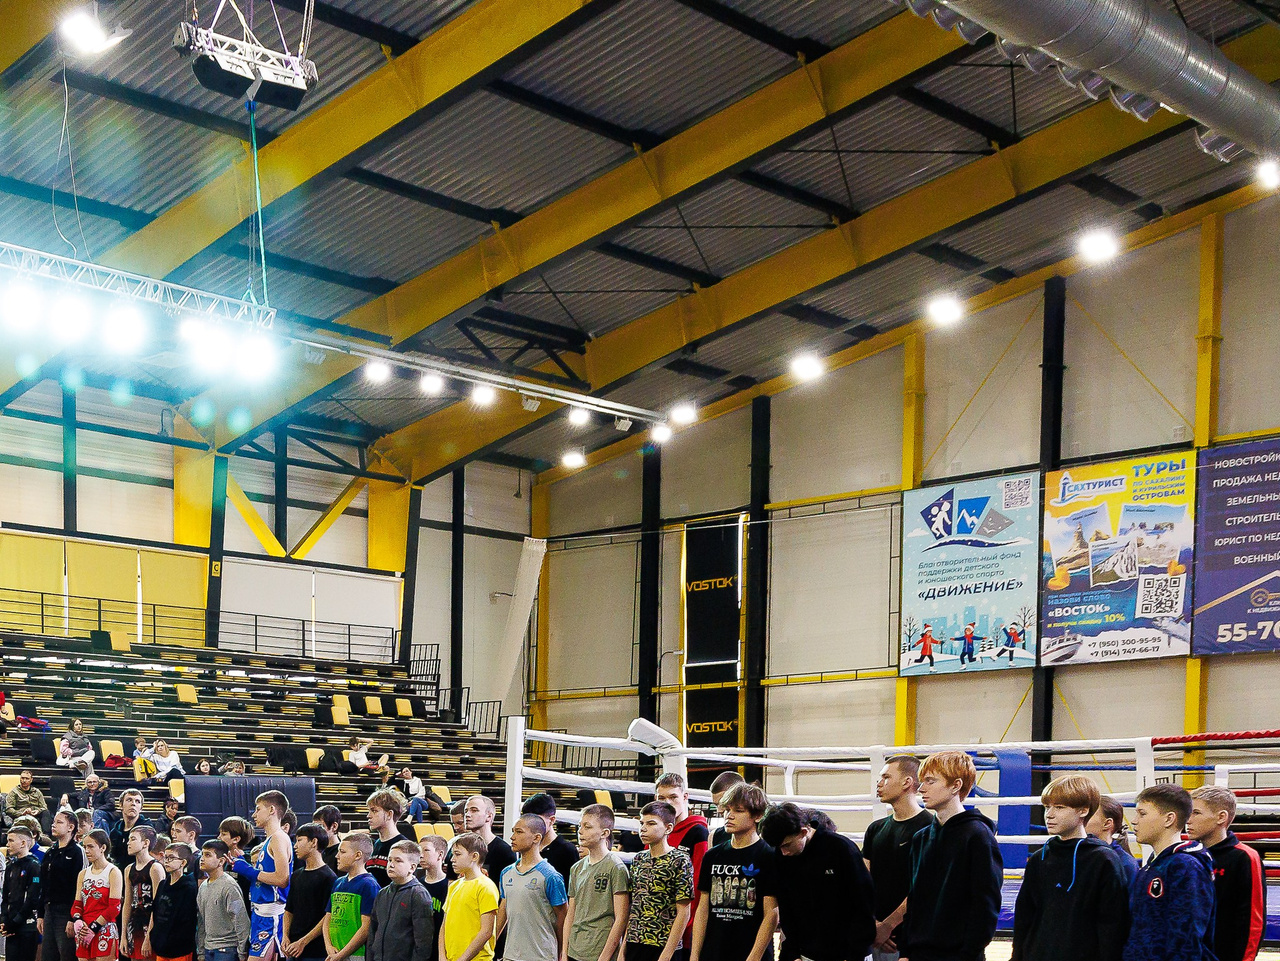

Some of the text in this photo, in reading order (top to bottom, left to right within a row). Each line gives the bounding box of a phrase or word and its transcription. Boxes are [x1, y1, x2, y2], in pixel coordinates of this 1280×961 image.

[1132, 459, 1186, 478] ТУРЫ
[1213, 474, 1262, 488] ПРОДАЖА
[1133, 489, 1185, 501] ОСТРОВАМ
[1214, 536, 1247, 546] ЮРИСТ
[1249, 535, 1262, 543] ПО
[918, 562, 999, 577] поддержки детского
[686, 576, 733, 592] VOSTOK
[925, 573, 974, 583] юношеского
[918, 579, 1023, 601] «ДВИЖЕНИЕ»
[1048, 604, 1111, 617] «ВОСТОК»
[1104, 613, 1126, 623] 10%
[1099, 640, 1119, 648] (950)
[686, 721, 733, 733] VOSTOK
[711, 864, 741, 875] FUCK
[595, 879, 607, 890] 99
